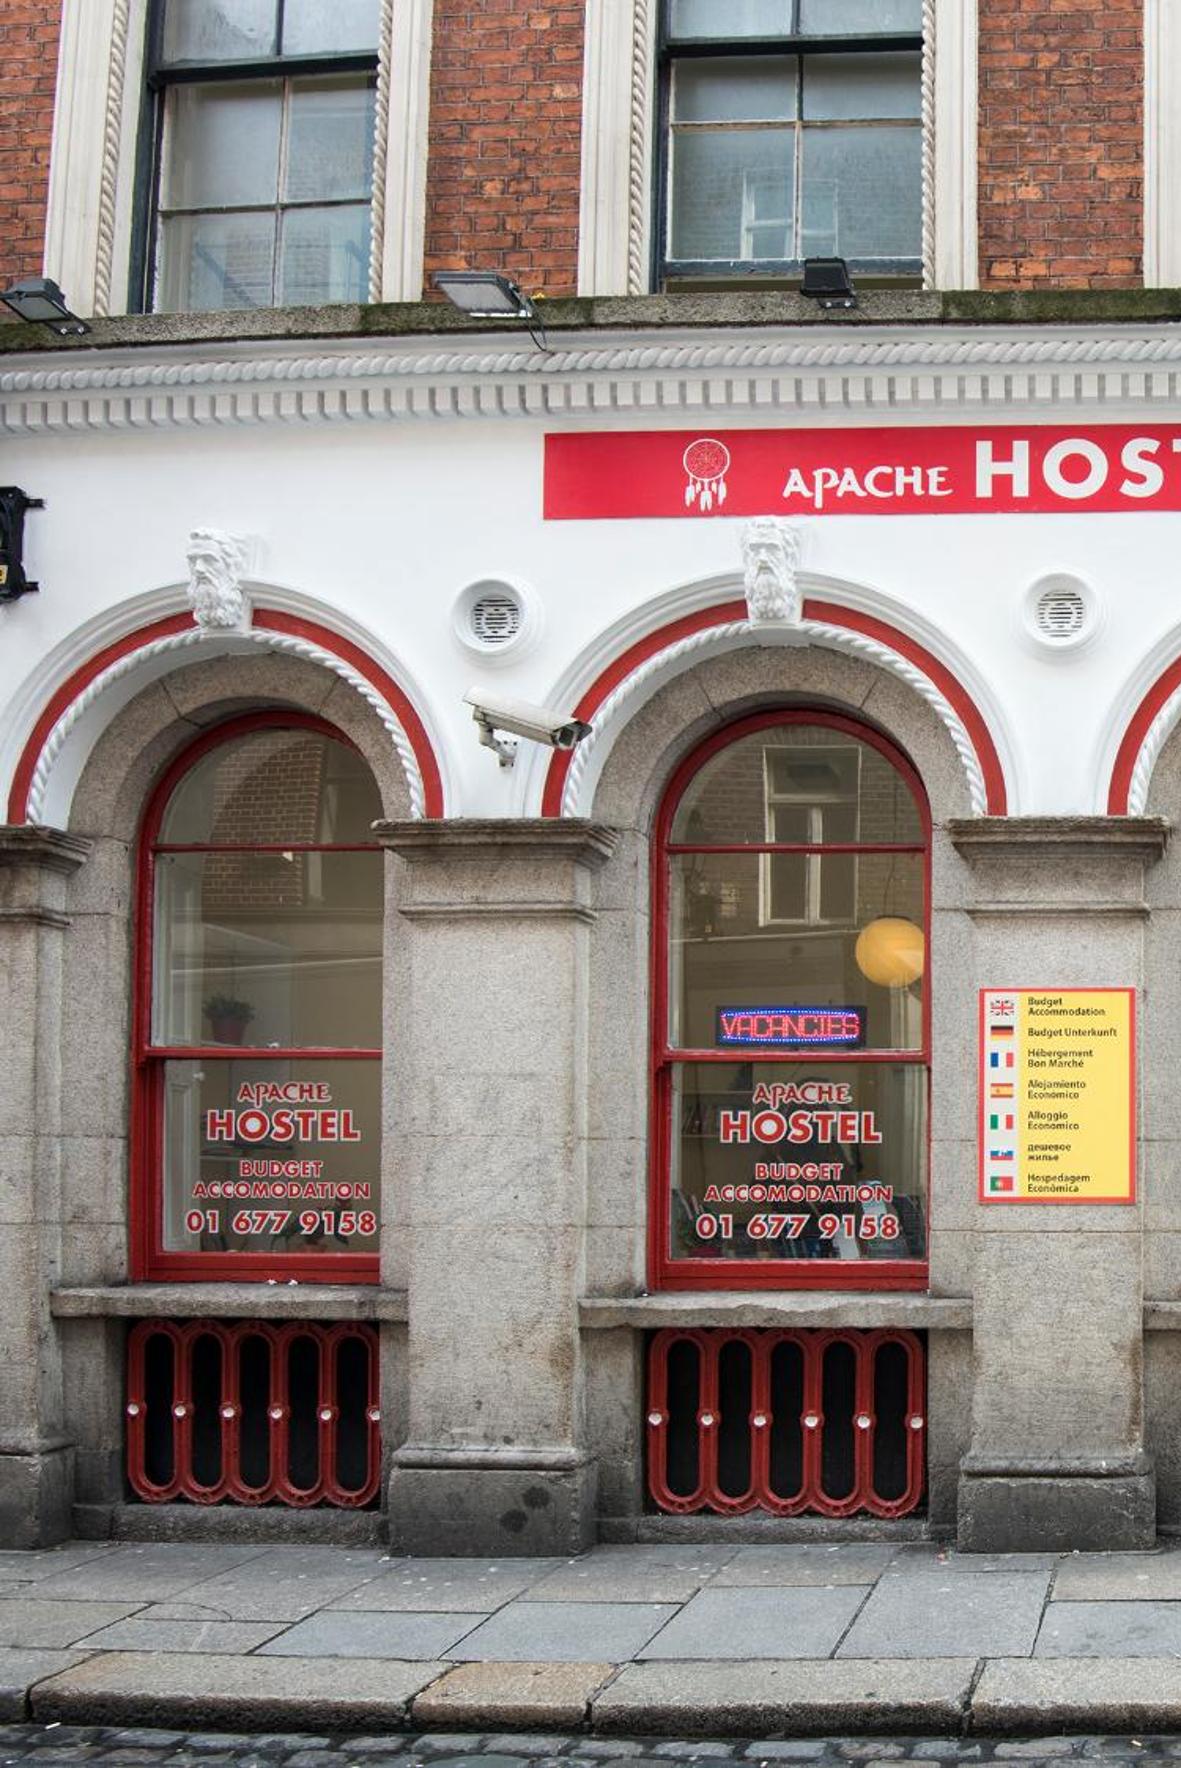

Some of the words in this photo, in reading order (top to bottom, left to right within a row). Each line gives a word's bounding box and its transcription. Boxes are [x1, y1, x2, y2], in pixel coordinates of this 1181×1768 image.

[782, 465, 954, 509] APACHE
[1028, 997, 1062, 1008] Budget
[1028, 1007, 1106, 1016] Accommodation
[720, 1015, 861, 1037] VACANCIES
[1028, 1028, 1062, 1039] Budget
[1064, 1027, 1117, 1037] Unterkunft
[1028, 1048, 1093, 1059] Hébergement
[1028, 1059, 1046, 1068] Bon
[1048, 1059, 1084, 1068] Marché
[238, 1082, 332, 1108] APACHE
[753, 1082, 852, 1110] APACHE
[1028, 1111, 1068, 1121] Alloggio
[206, 1110, 361, 1142] HOSTEL
[720, 1110, 882, 1144] HOSTEL
[240, 1160, 323, 1177] BUDGET
[755, 1163, 844, 1180] BUDGET
[1028, 1173, 1090, 1184] Hospedagem
[192, 1181, 370, 1199] ACCOMODATION
[704, 1185, 893, 1202] ACCOMODATION
[186, 1209, 219, 1234] 01
[233, 1209, 291, 1234] 677
[300, 1210, 376, 1235] 9158
[696, 1213, 733, 1239] 01
[747, 1213, 810, 1239] 677
[818, 1213, 899, 1240] 9158
